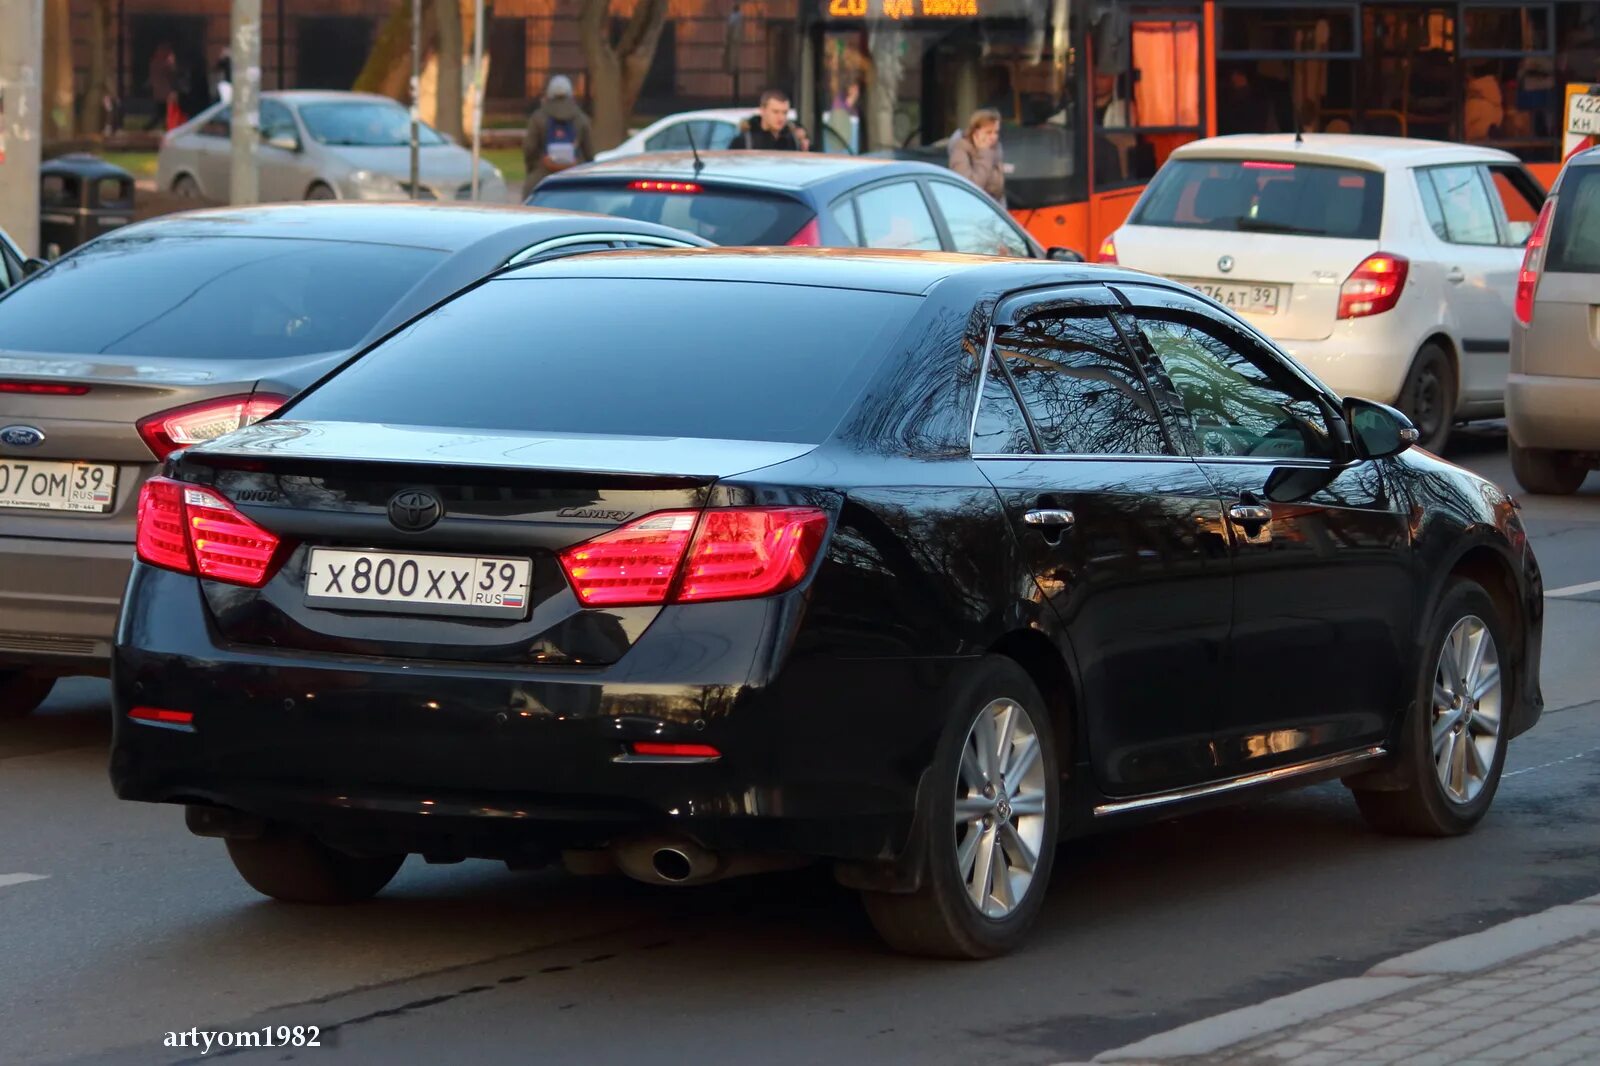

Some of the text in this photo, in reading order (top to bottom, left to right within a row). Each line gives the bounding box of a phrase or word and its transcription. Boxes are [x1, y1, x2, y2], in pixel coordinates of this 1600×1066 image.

[1254, 287, 1271, 302] 39
[75, 466, 104, 490] 39
[72, 491, 94, 500] RUS
[478, 561, 516, 592] 39
[475, 593, 502, 605] RUS
